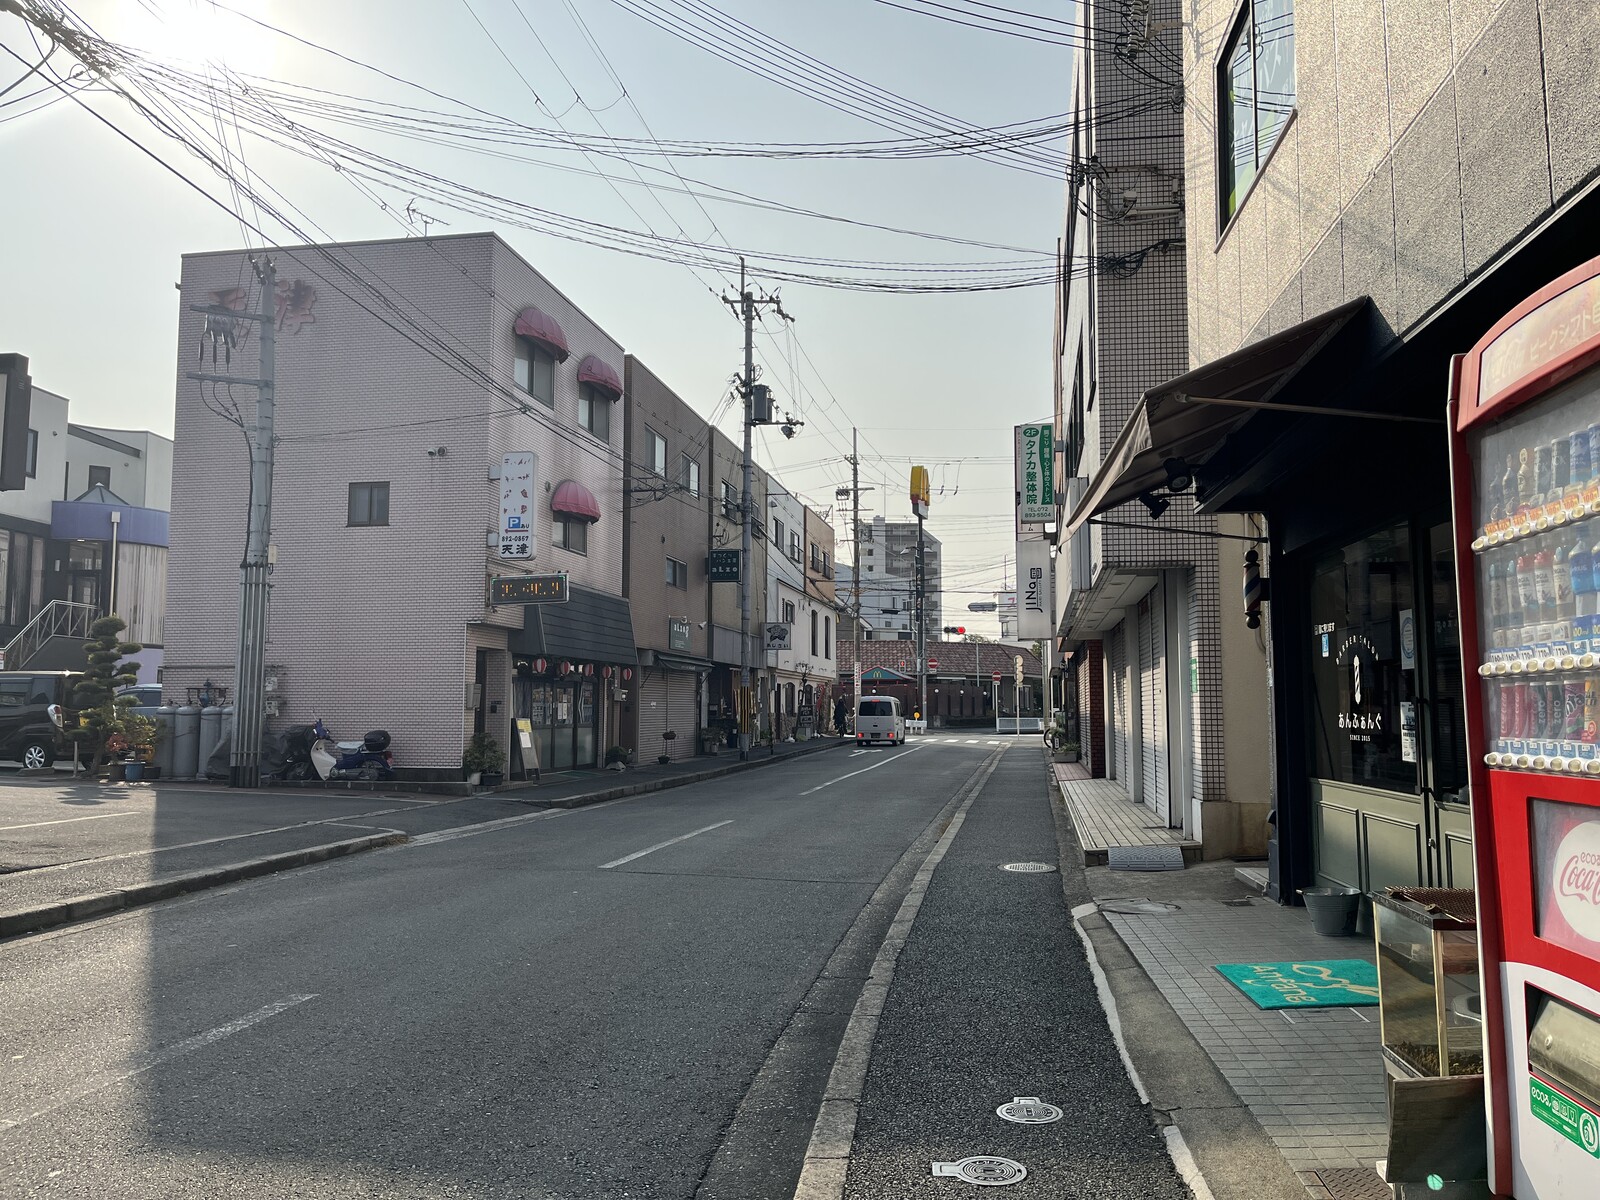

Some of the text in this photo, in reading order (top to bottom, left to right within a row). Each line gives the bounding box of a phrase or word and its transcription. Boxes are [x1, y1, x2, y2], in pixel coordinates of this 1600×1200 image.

[1025, 429, 1037, 437] 2F
[1025, 439, 1038, 505] タナカ整体院
[509, 517, 520, 528] P
[501, 543, 529, 555] 天津
[1338, 712, 1382, 731] あんふぁんぐ
[1538, 700, 1546, 724] zero
[1553, 700, 1562, 725] zero
